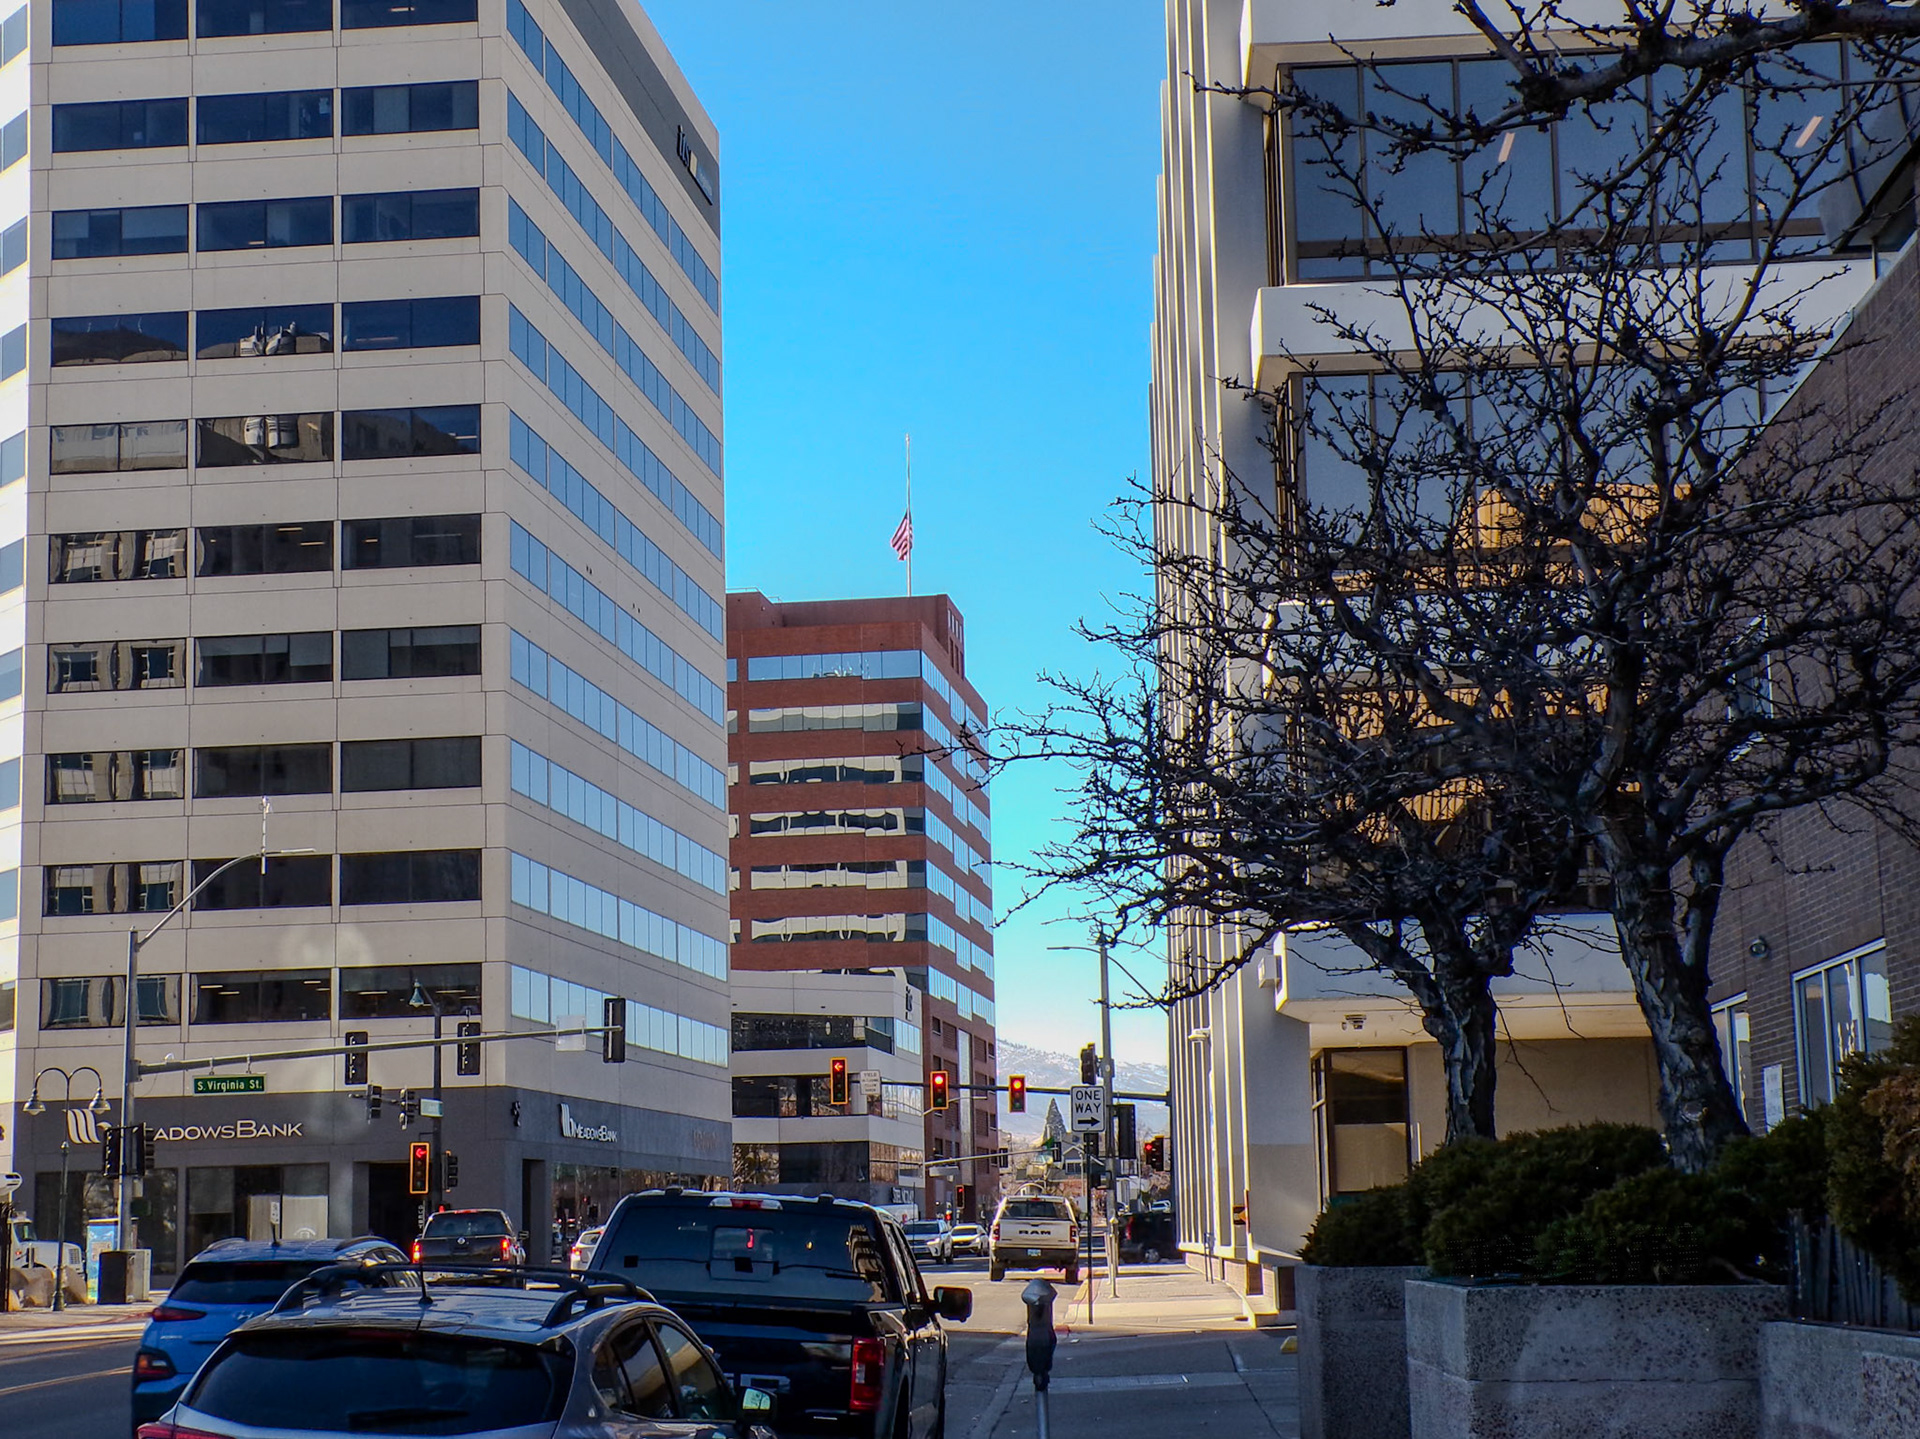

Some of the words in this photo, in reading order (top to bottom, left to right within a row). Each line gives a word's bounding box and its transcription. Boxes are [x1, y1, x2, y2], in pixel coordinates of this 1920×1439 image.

[197, 1081, 206, 1091] S.
[207, 1080, 245, 1092] Virginia
[249, 1079, 262, 1089] St.
[1076, 1090, 1101, 1101] ONE
[1075, 1103, 1101, 1113] WAY
[153, 1119, 303, 1142] ADOWSBANK
